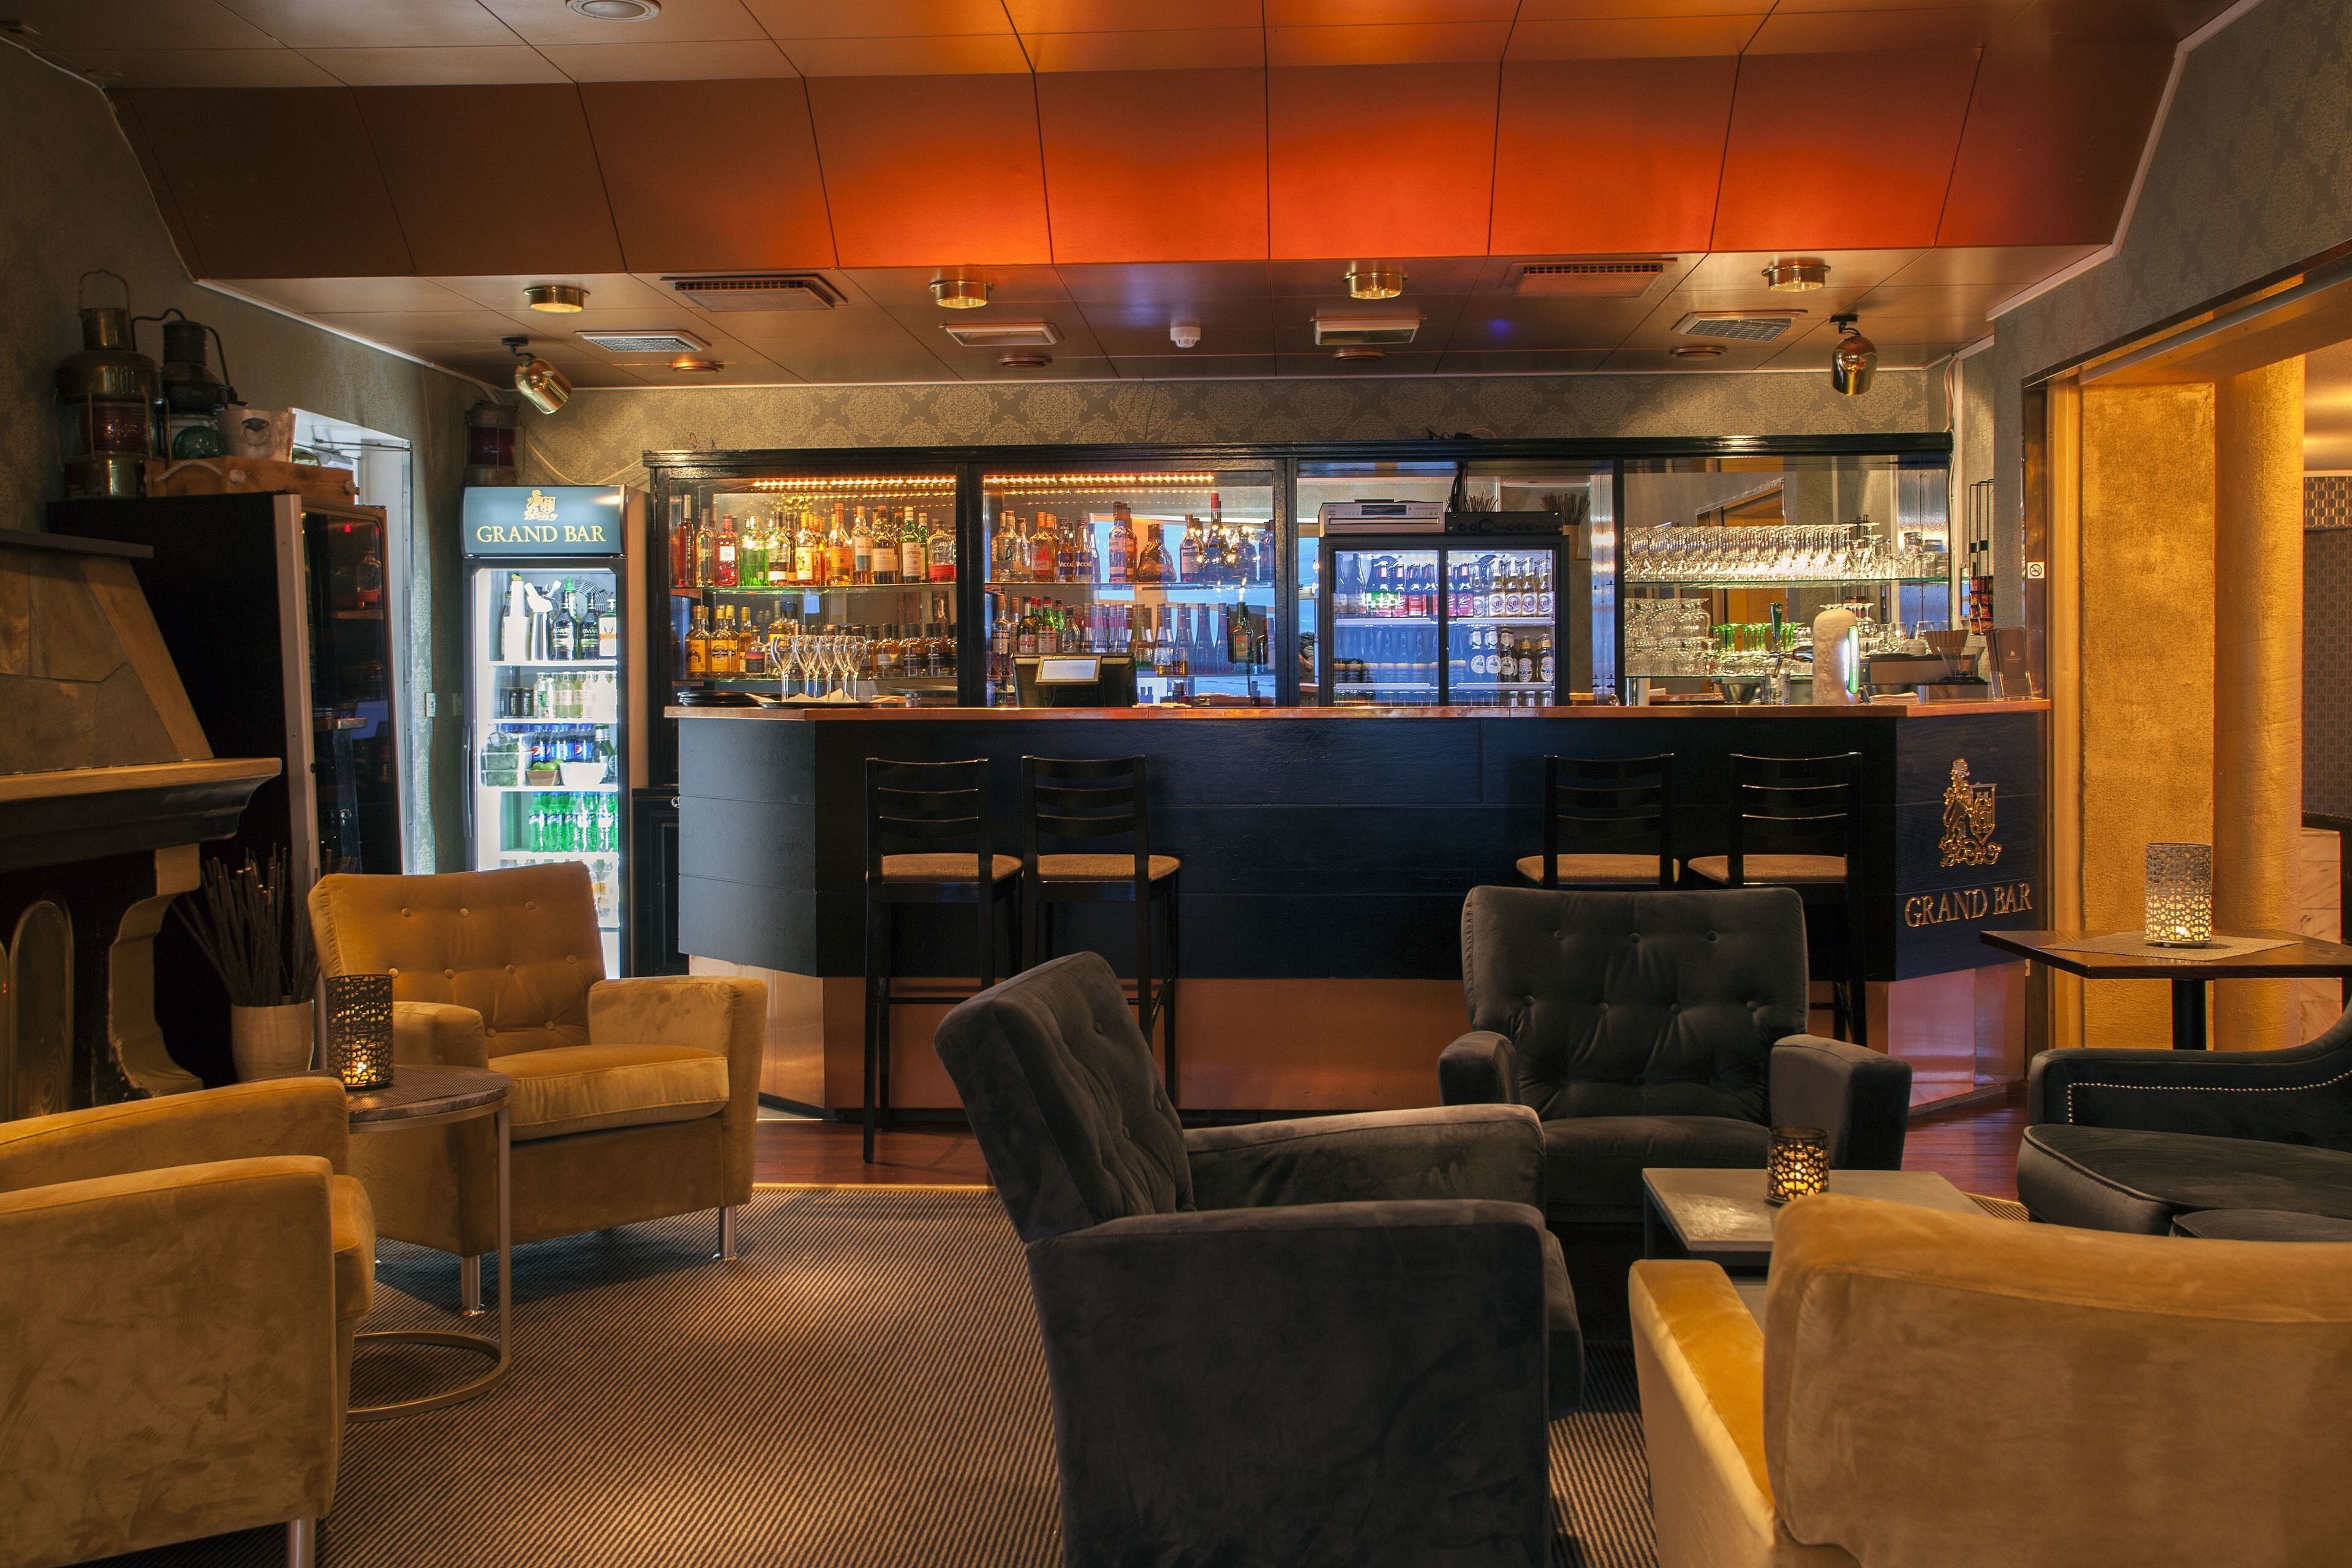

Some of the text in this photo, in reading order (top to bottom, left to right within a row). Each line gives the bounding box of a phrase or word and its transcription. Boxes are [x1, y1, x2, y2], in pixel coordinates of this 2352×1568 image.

[476, 526, 606, 542] GRAND BAR
[1904, 883, 2033, 927] GRAND BAR
